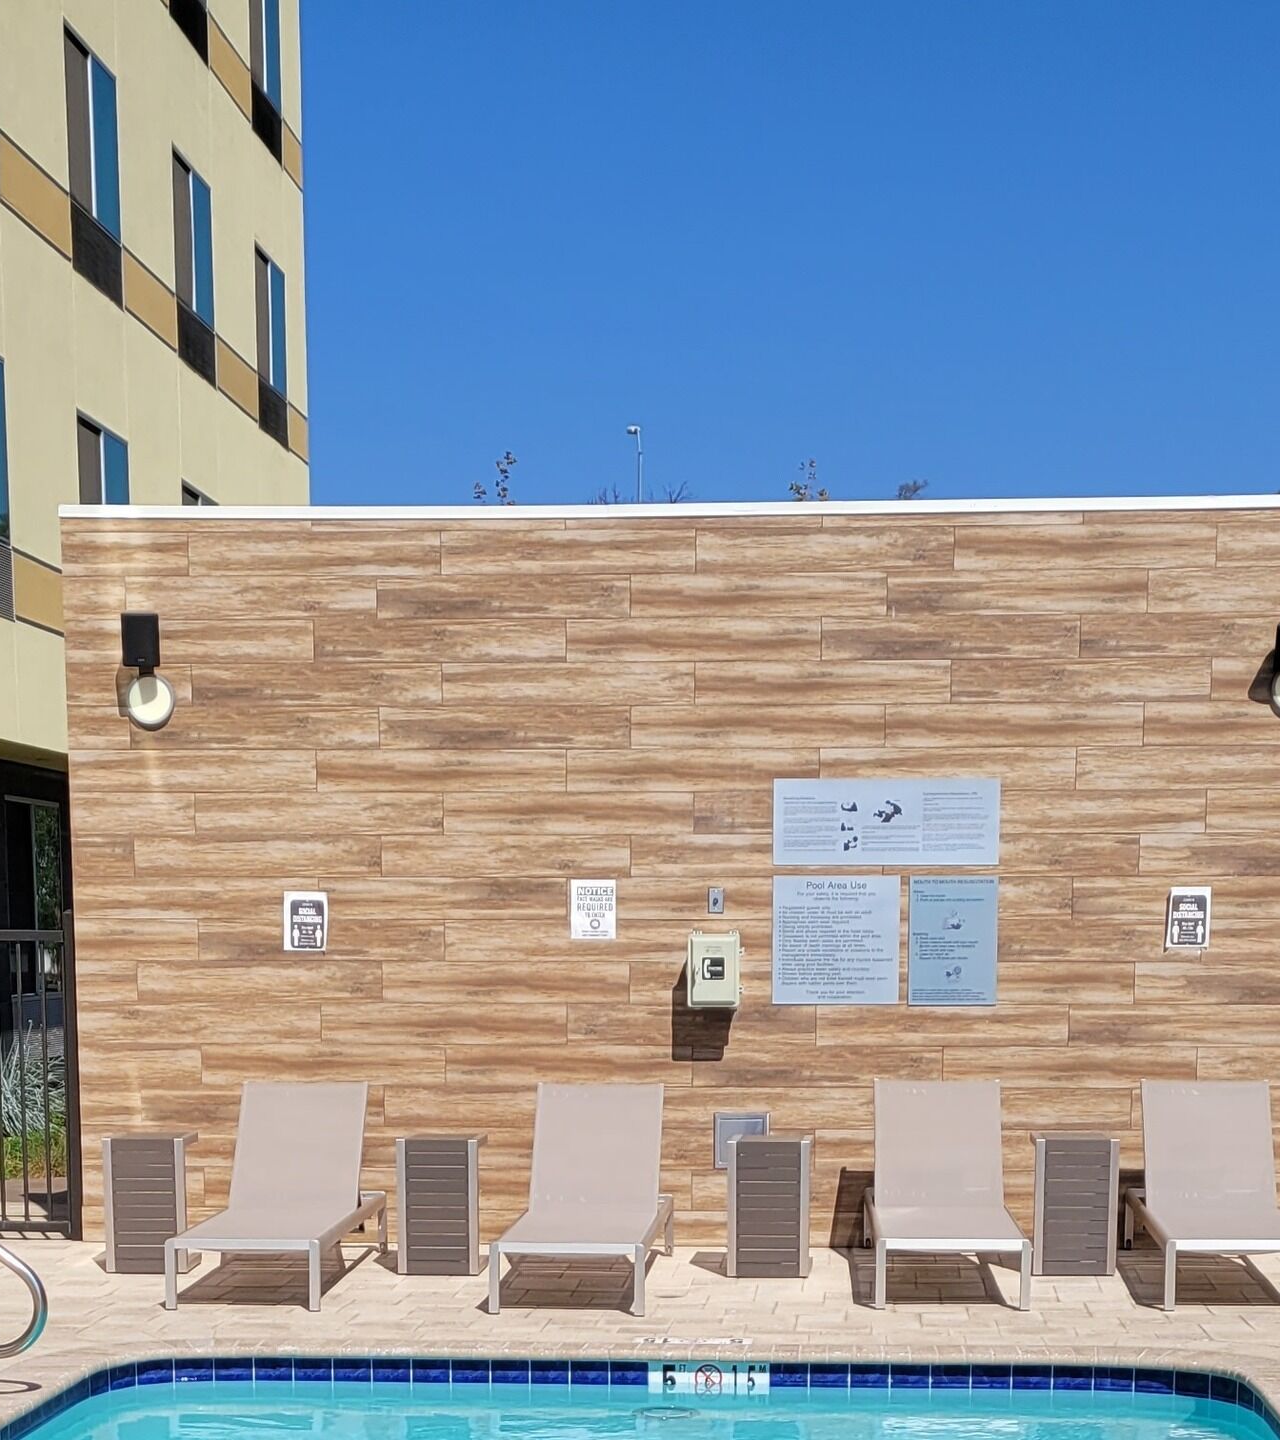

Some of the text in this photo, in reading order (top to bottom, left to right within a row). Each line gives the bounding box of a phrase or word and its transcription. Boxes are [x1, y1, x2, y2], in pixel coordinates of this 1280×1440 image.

[806, 881, 867, 890] Pool Area Use
[577, 903, 613, 911] REQUIRED
[759, 1364, 767, 1373] M
[662, 1364, 676, 1385] 5
